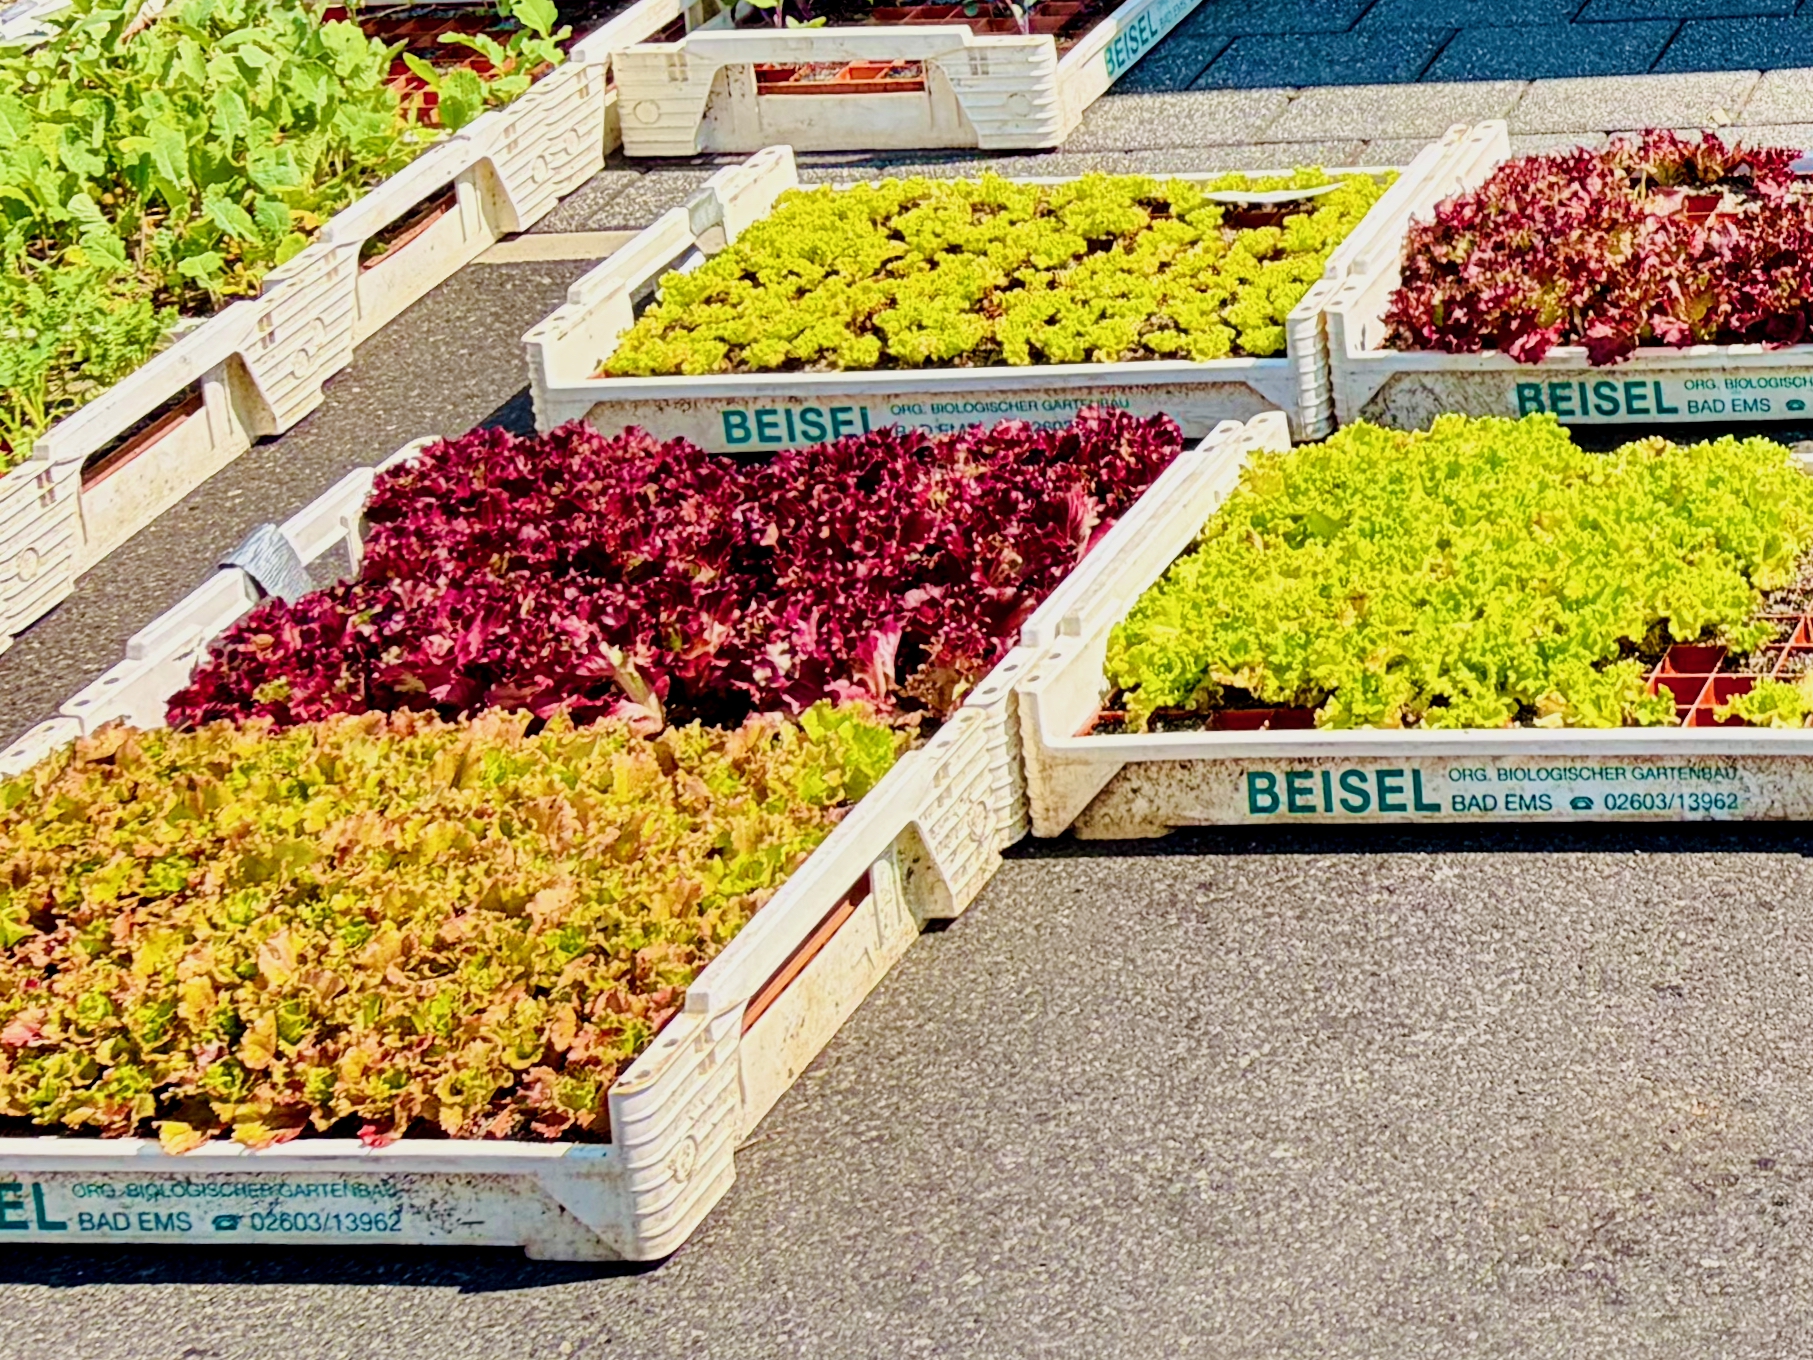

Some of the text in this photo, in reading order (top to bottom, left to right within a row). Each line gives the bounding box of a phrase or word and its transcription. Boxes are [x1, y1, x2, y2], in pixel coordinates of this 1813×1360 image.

[1104, 10, 1158, 78] BEISEL
[1684, 378, 1720, 392] ORG.
[890, 405, 927, 416] ORG.
[932, 399, 1039, 415] BIOLOGISCHER
[1517, 379, 1679, 418] BEISEL
[1687, 399, 1725, 414] BAD
[1732, 398, 1772, 413] EMS
[1448, 765, 1739, 782] ORG. BIOLOGISCHER GARTENBAU
[1246, 768, 1442, 814] BEISEL
[1452, 792, 1739, 812] BAD EMS 02603/13962
[126, 1182, 277, 1198] BIOLOGISCHER
[79, 1212, 402, 1232] BAD EMS 02603/13962
